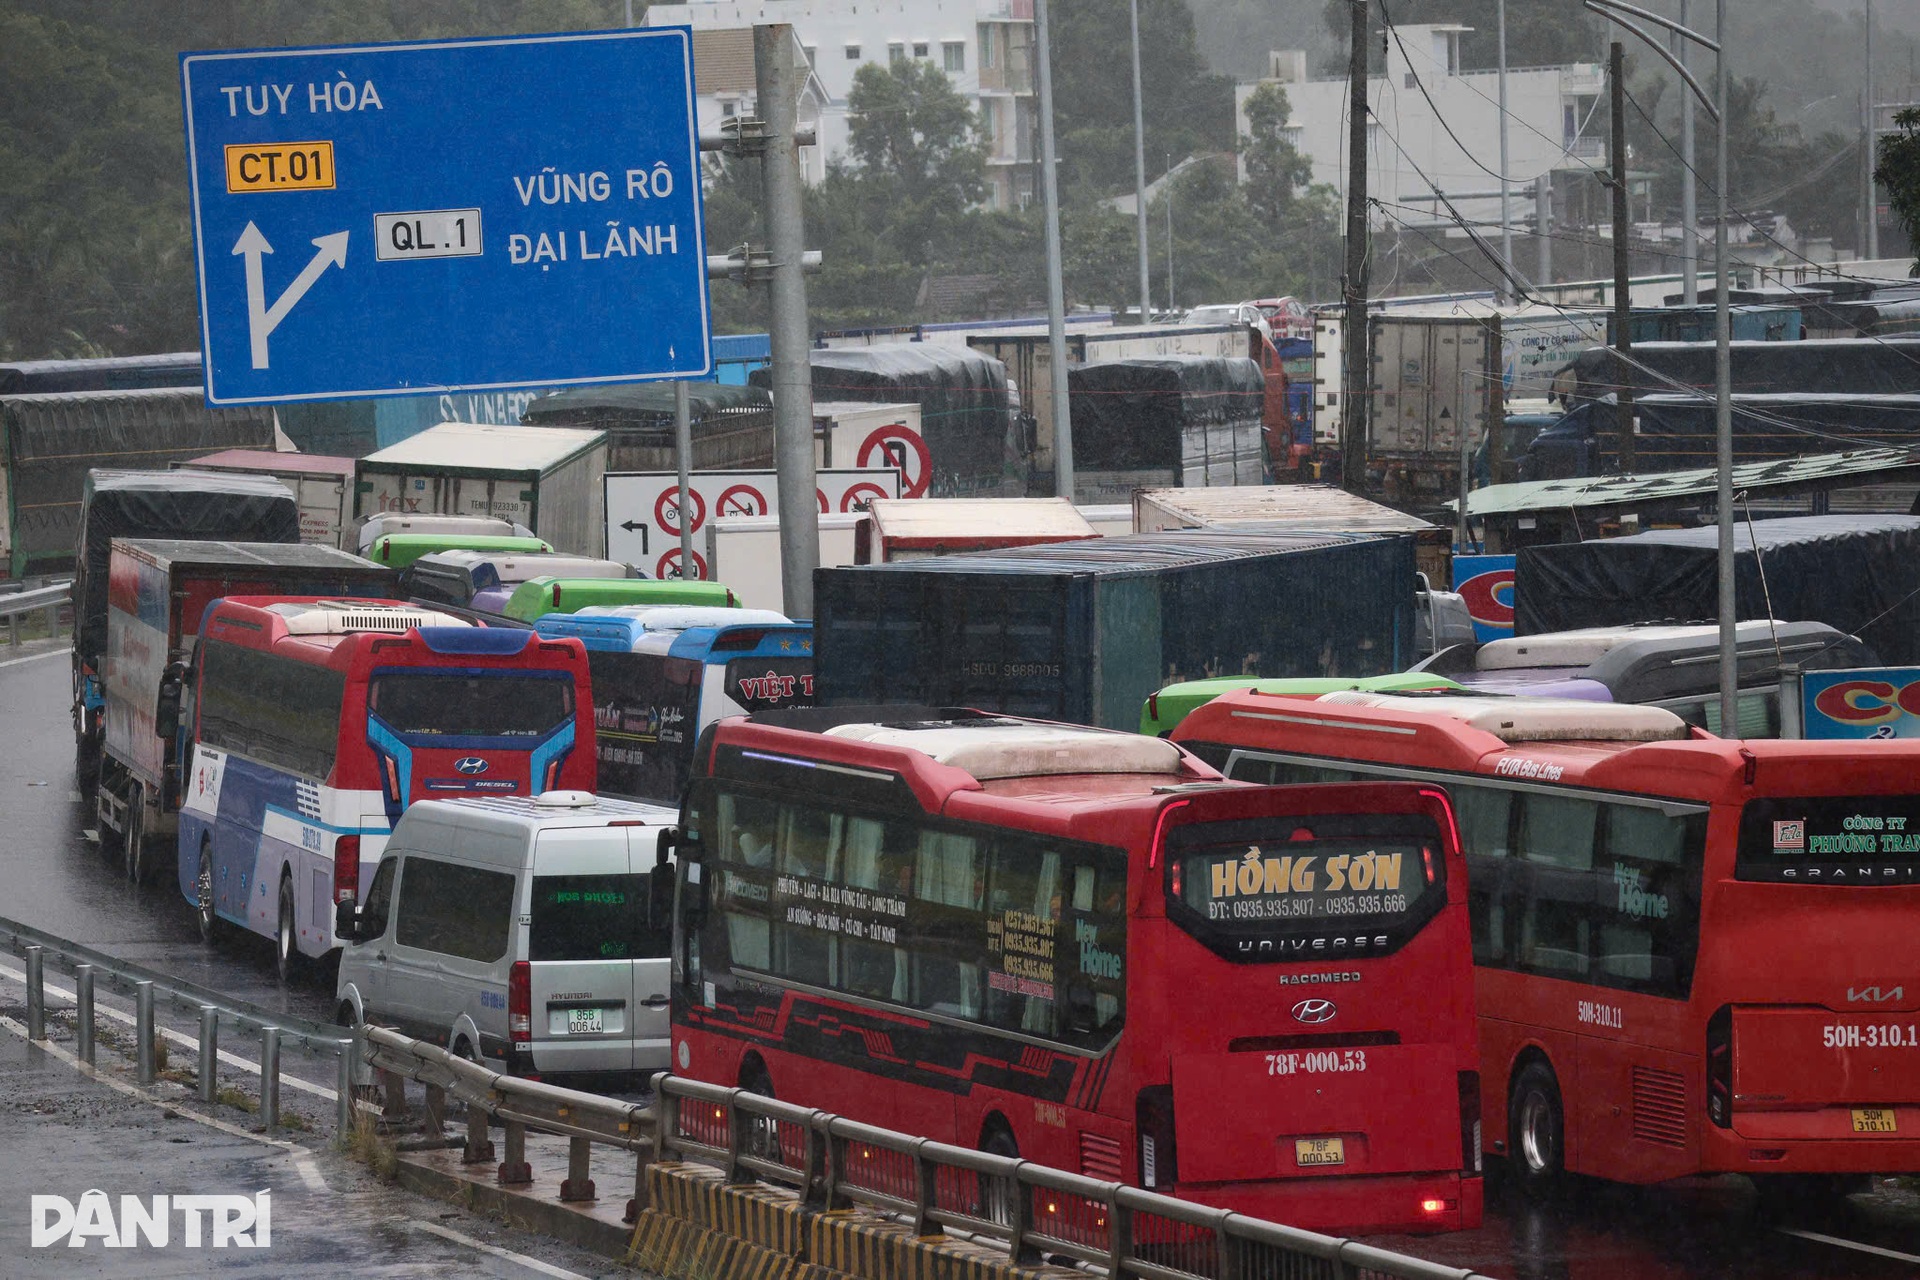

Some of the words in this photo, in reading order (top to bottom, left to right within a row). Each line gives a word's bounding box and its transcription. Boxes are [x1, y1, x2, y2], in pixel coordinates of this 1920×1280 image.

[220, 84, 294, 117] TUY
[308, 70, 384, 114] HÒA
[239, 150, 322, 184] CT.01
[513, 166, 611, 206] VŨNG
[626, 160, 673, 199] RÔ
[508, 231, 567, 272] ĐẠI
[579, 220, 678, 260] LÃNH
[739, 670, 795, 703] VIỆT
[1843, 814, 1883, 830] CÔNG
[1886, 817, 1907, 830] TY
[1809, 832, 1876, 853] PHƯƠNG
[1211, 846, 1318, 898] HỒNG
[1324, 850, 1402, 892] SƠN
[1783, 868, 1912, 877] GRANBI
[1234, 898, 1314, 918] 0935.935.807
[1326, 894, 1406, 914] 0935.935.666
[1618, 884, 1669, 919] Home
[1238, 935, 1388, 951] UNIVERSE
[551, 992, 593, 1000] HYUNDAI
[576, 1009, 595, 1020] 85B
[1578, 1000, 1622, 1028] 50H-310.11
[570, 1021, 602, 1032] 006.44
[1823, 1024, 1918, 1047] 50H-310.1
[1265, 1050, 1367, 1076] 78F-000.53
[1858, 1121, 1891, 1131] 310.11
[1864, 1110, 1883, 1120] 50H
[1309, 1140, 1329, 1152] 78F
[1303, 1152, 1339, 1163] 000.53
